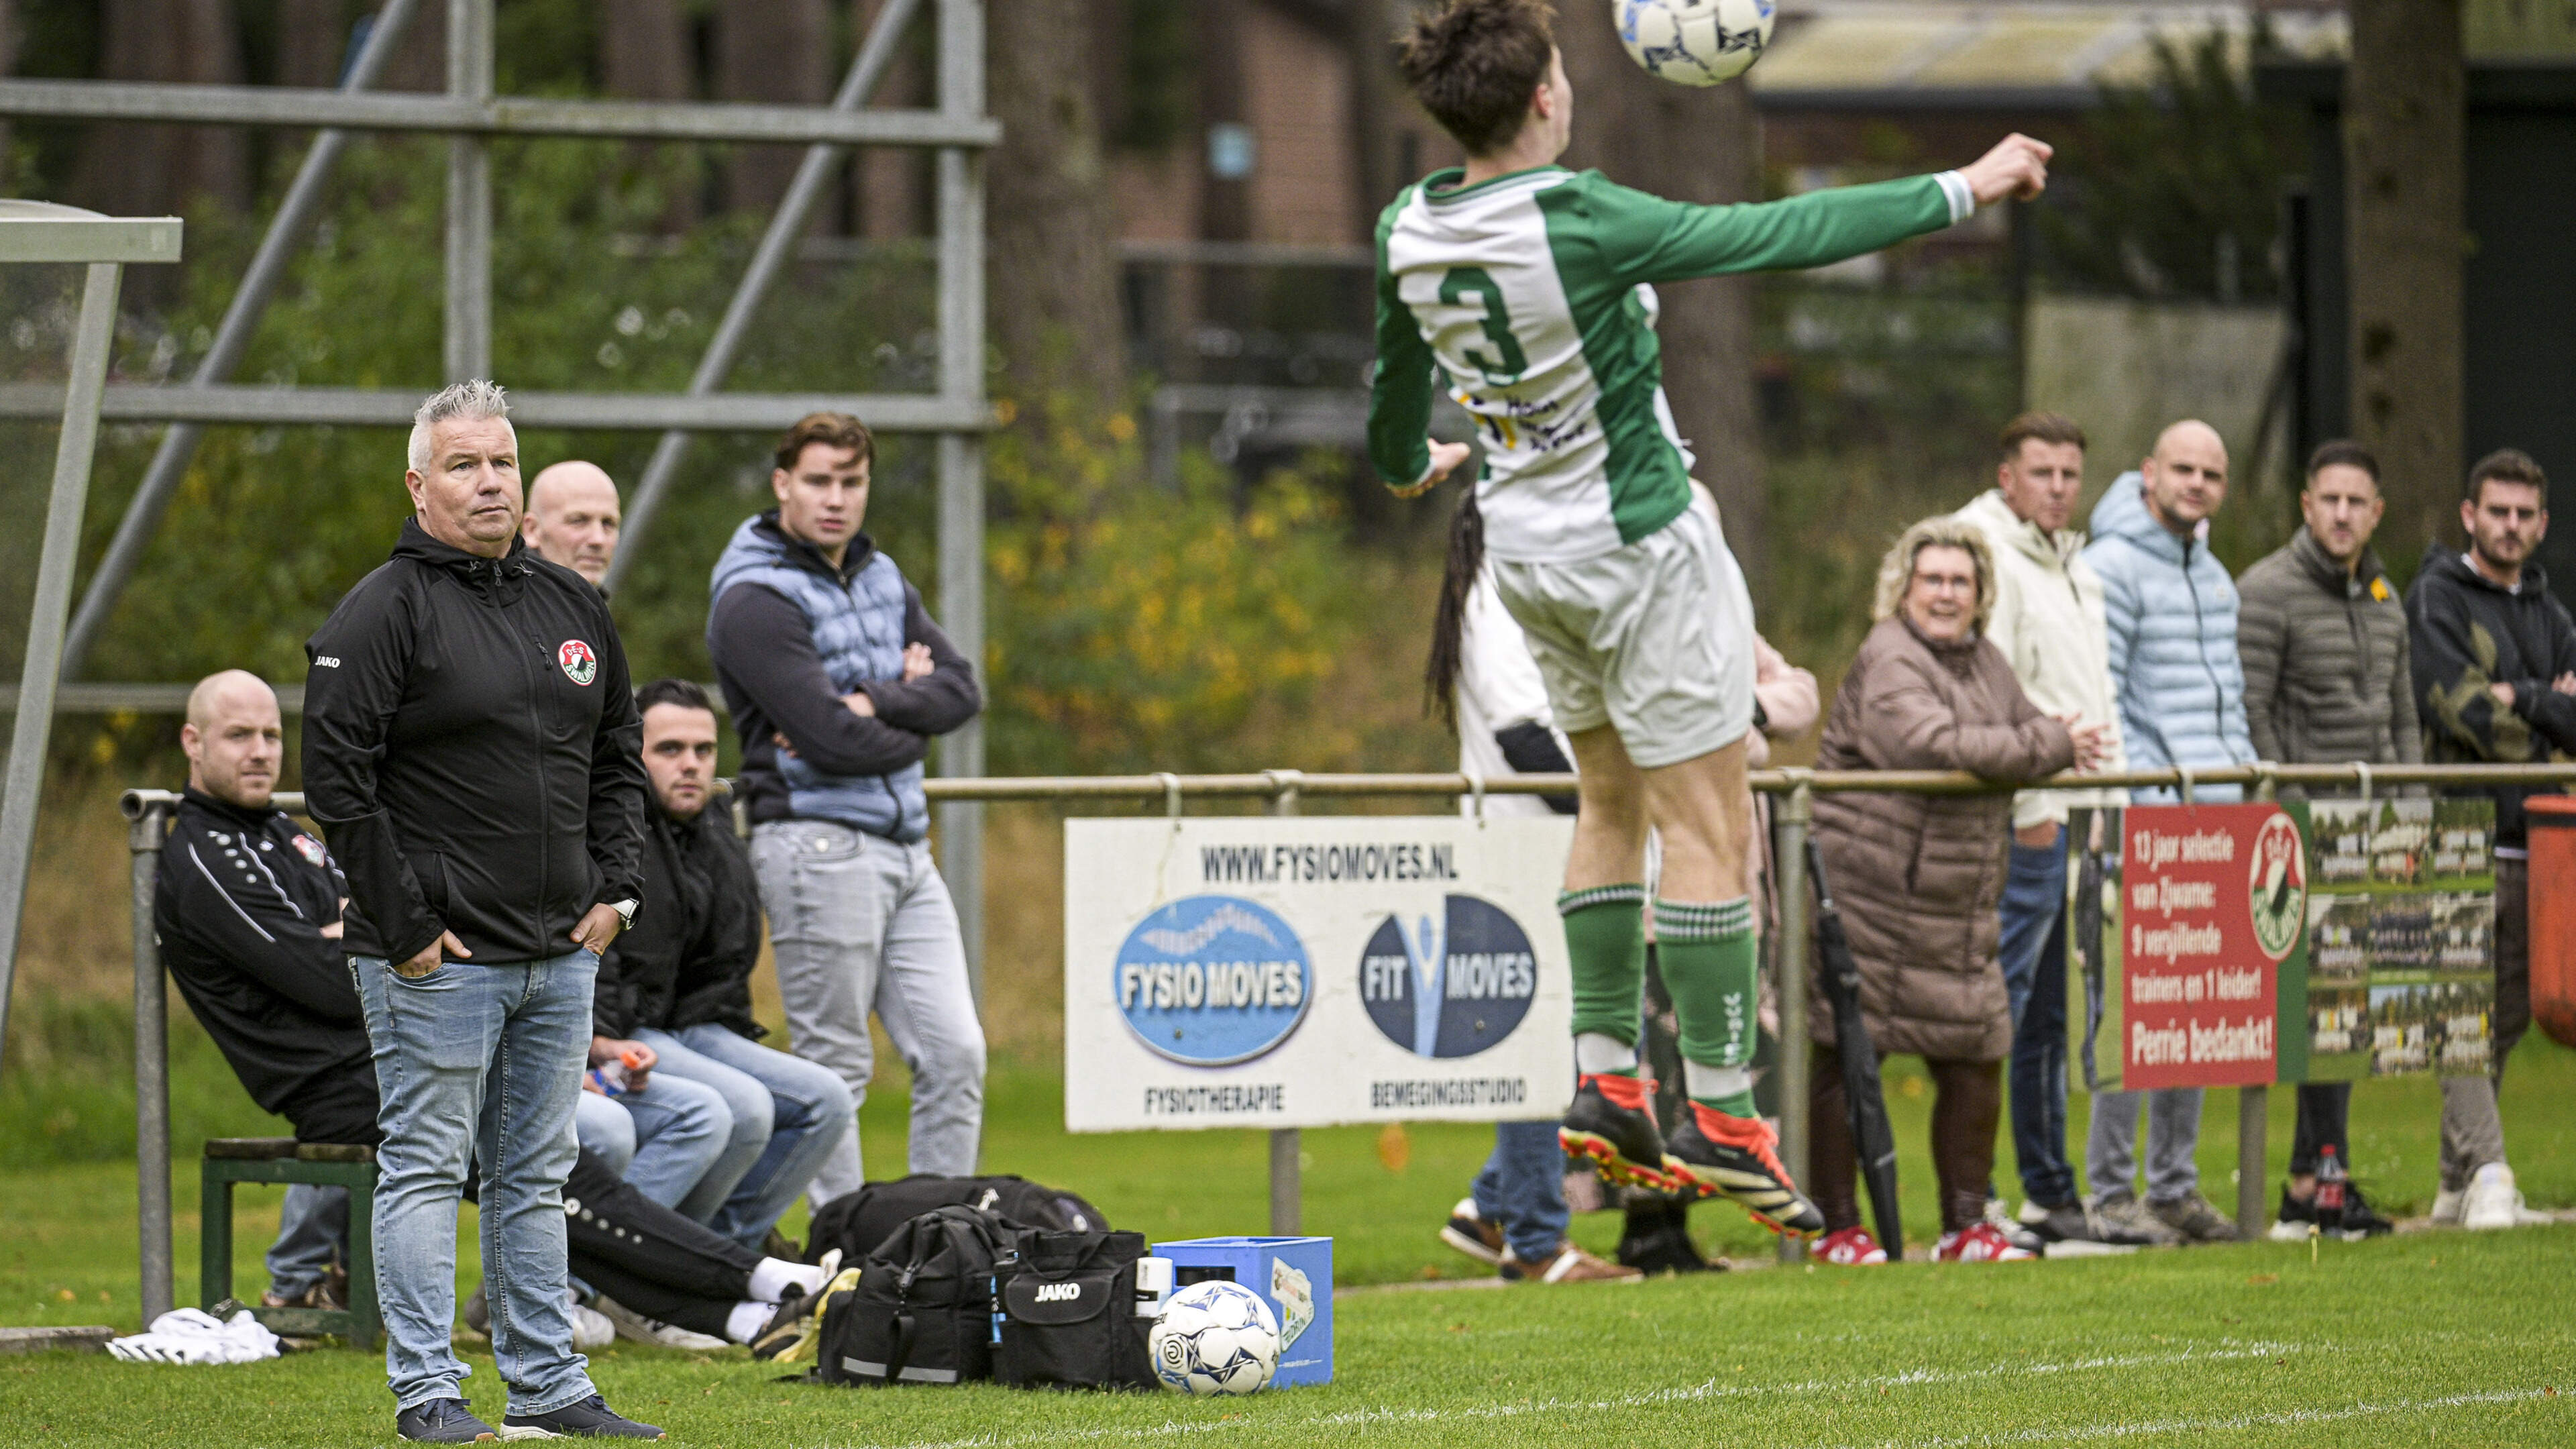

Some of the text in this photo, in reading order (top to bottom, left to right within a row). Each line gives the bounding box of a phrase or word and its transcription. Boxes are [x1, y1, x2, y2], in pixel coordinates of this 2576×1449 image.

[1440, 266, 1528, 387] 3
[315, 655, 341, 669] JAKO
[565, 661, 595, 682] SWALMEN
[1201, 843, 1459, 881] WWW.FYSIOMOVES.NL
[2133, 830, 2151, 864] 13
[2182, 826, 2235, 863] selectie
[2132, 882, 2158, 910] van
[2132, 923, 2143, 958] 9
[1122, 960, 1303, 1009] FYSIO MOVES
[1365, 952, 1534, 1001] FIT MOVES
[2131, 965, 2261, 1004] trainers en 1 leider!
[2132, 1014, 2273, 1066] Perrie bedankt!
[1144, 1083, 1285, 1114] FYSIOTHERAPIE
[1371, 1077, 1527, 1108] BEWEGINGSSTUDIO
[1034, 1282, 1081, 1302] JAKO
